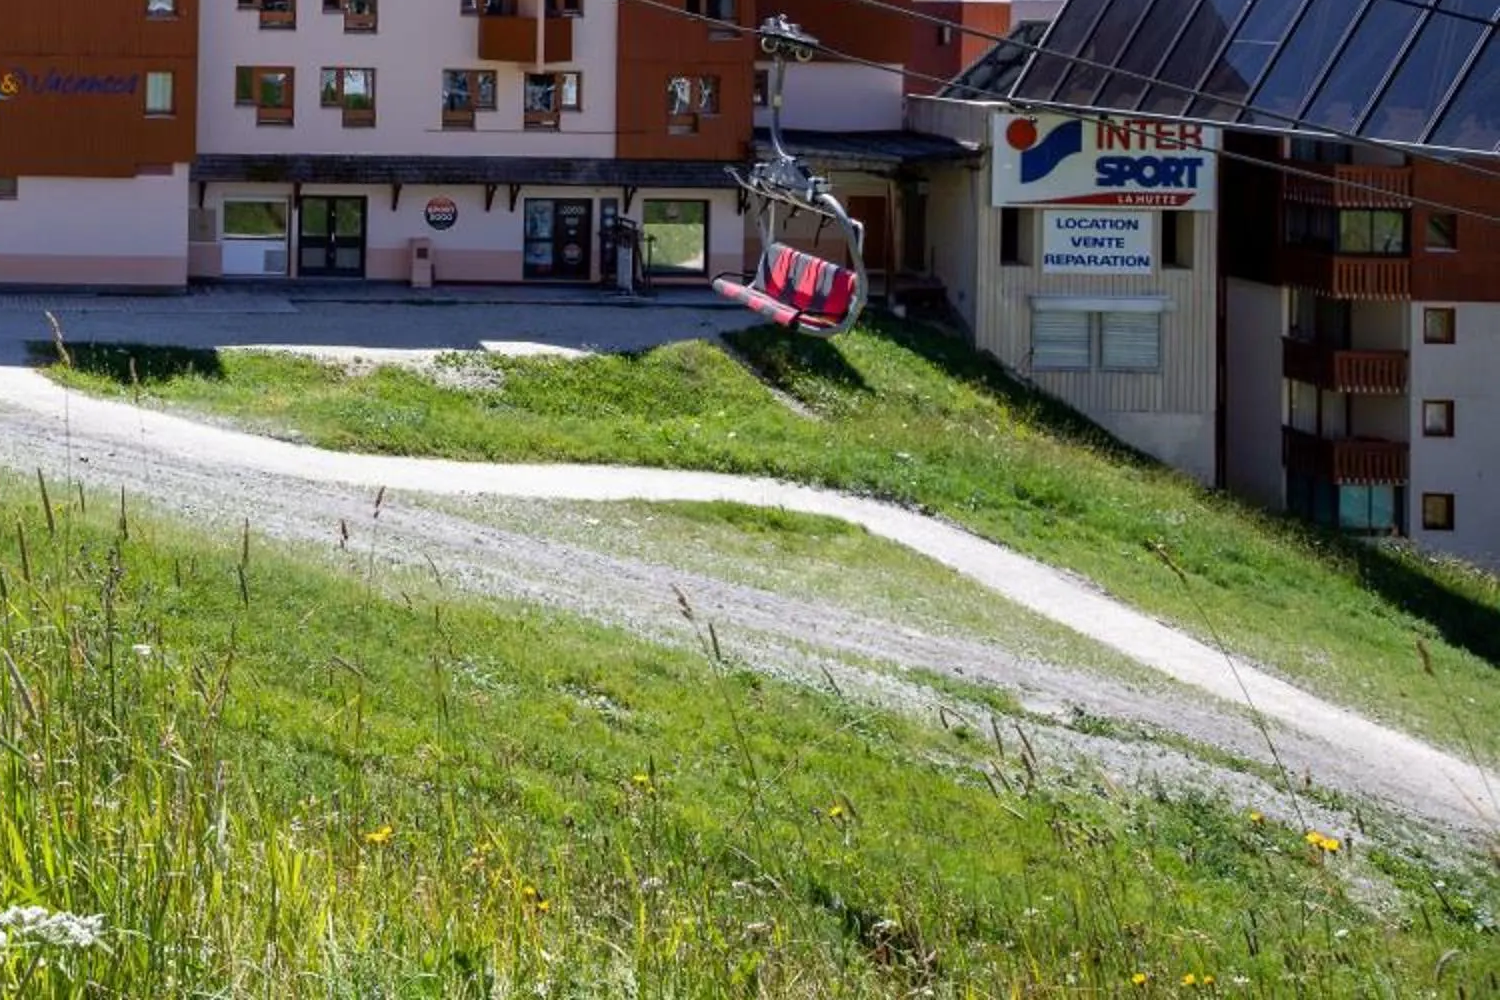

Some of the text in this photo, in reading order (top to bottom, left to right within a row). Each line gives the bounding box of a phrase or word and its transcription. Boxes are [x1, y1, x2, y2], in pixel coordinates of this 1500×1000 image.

[1096, 119, 1203, 151] INTER
[1095, 156, 1204, 188] SPORT
[1056, 217, 1139, 230] LOCATION
[1070, 236, 1125, 248] VENTE
[1044, 253, 1151, 267] REPARATION
